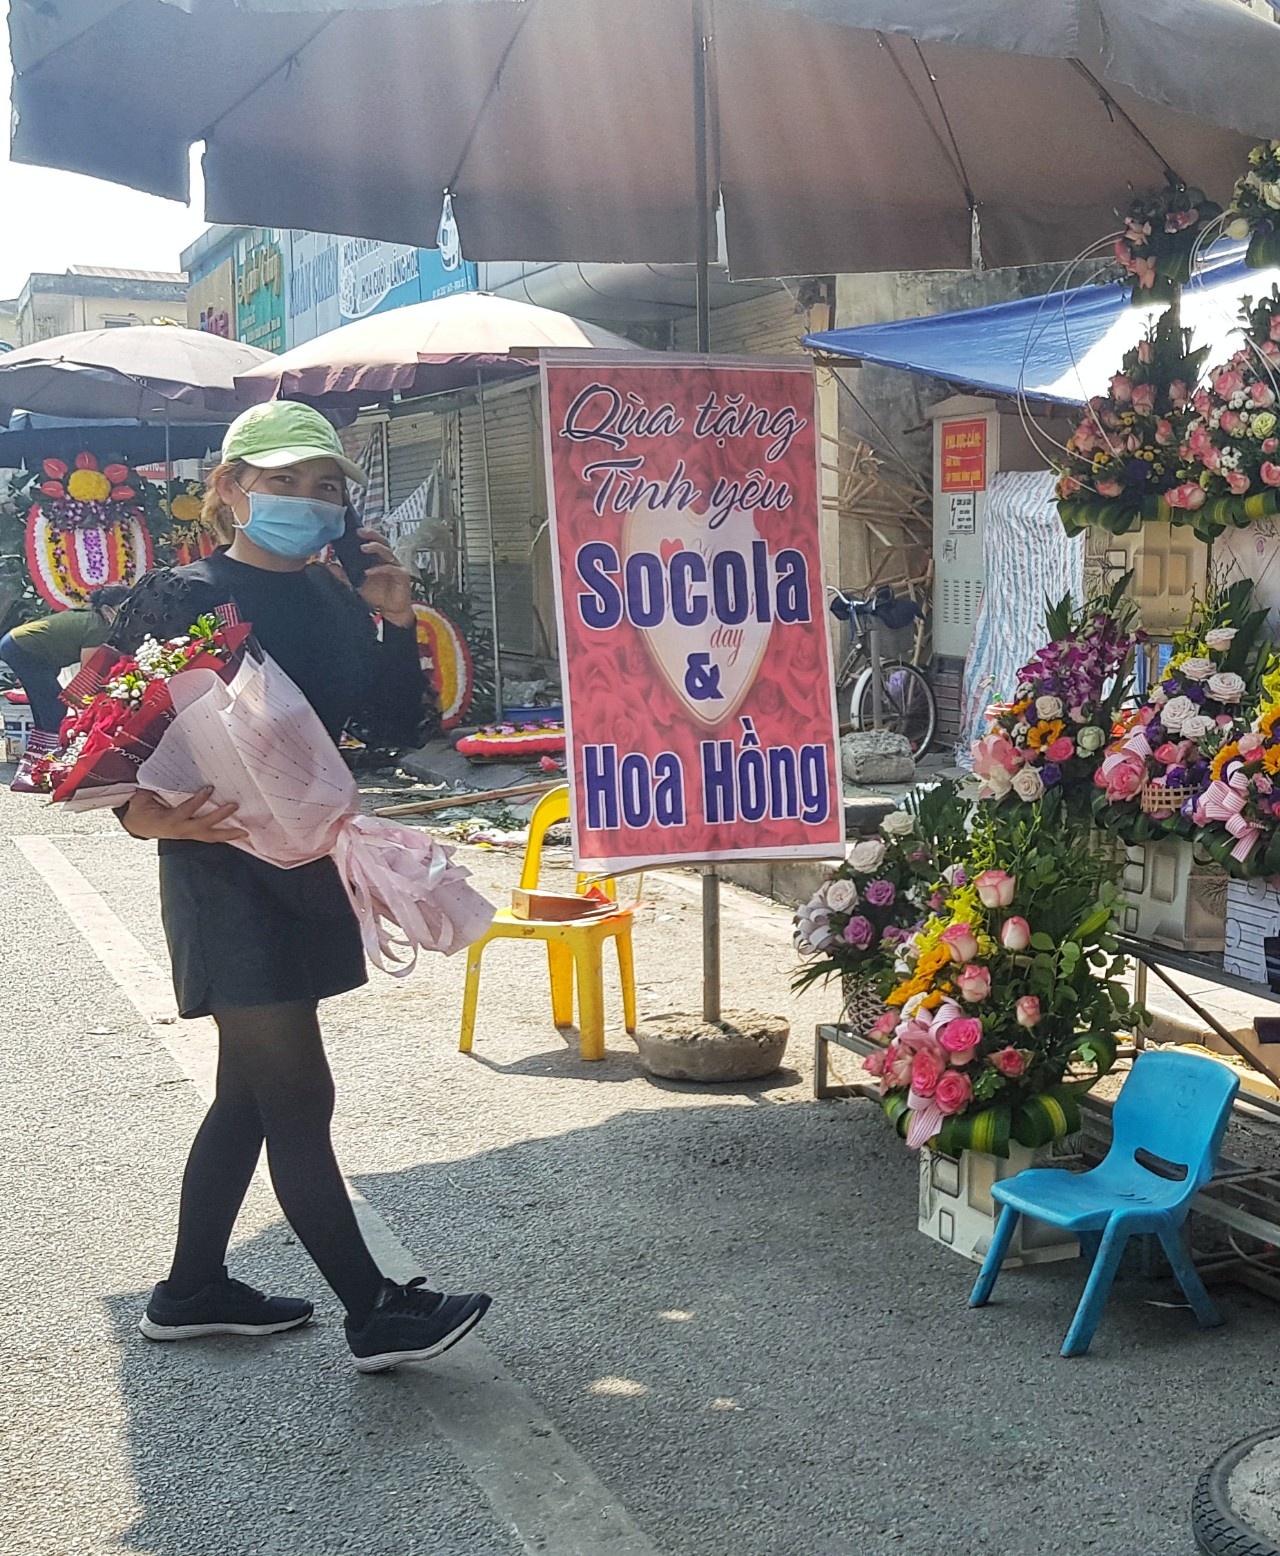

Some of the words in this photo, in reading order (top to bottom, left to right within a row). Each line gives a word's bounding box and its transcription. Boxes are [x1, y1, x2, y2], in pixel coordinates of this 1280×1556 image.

[694, 394, 807, 462] tặng
[583, 456, 702, 517] Tình
[701, 471, 792, 529] yêu
[575, 539, 813, 632] Socola
[684, 652, 725, 701] &
[710, 624, 745, 667] day
[583, 744, 687, 830] Hoa
[700, 715, 830, 826] Hồng
